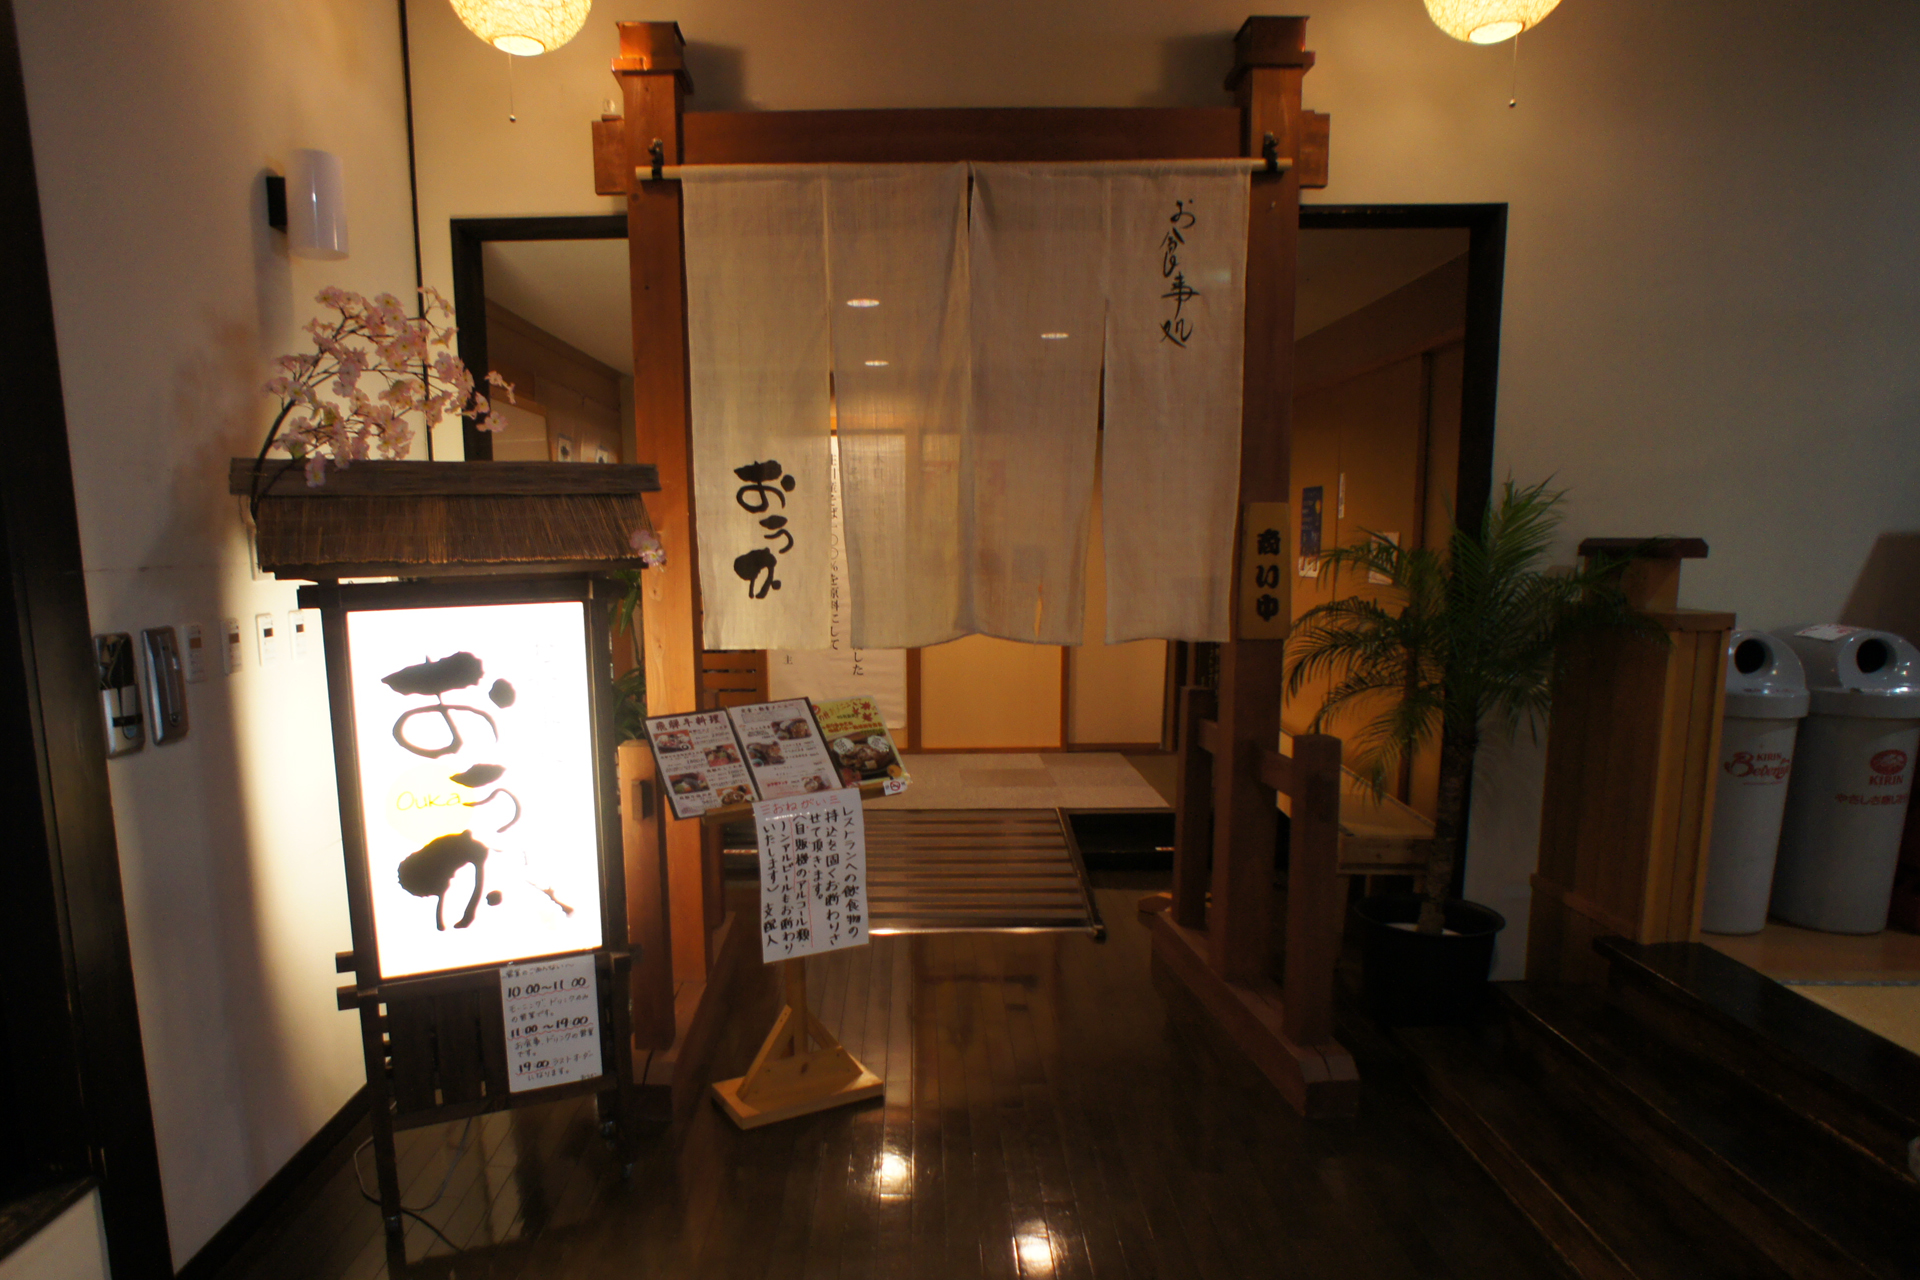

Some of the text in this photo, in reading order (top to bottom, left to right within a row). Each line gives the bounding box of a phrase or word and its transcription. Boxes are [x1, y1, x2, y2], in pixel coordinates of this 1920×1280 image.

[1160, 199, 1200, 349] お食事処
[733, 460, 795, 599] おうか
[1256, 528, 1281, 622] 商い中
[656, 714, 720, 731] 飛騨牛料理
[1757, 753, 1782, 762] KIRIN
[381, 651, 521, 932] おうか
[396, 789, 462, 812] Ouka
[1868, 775, 1905, 786] KIRIN
[780, 821, 796, 954] ノンアルビールもお断わり
[842, 806, 861, 938] レストランへの飲食物の
